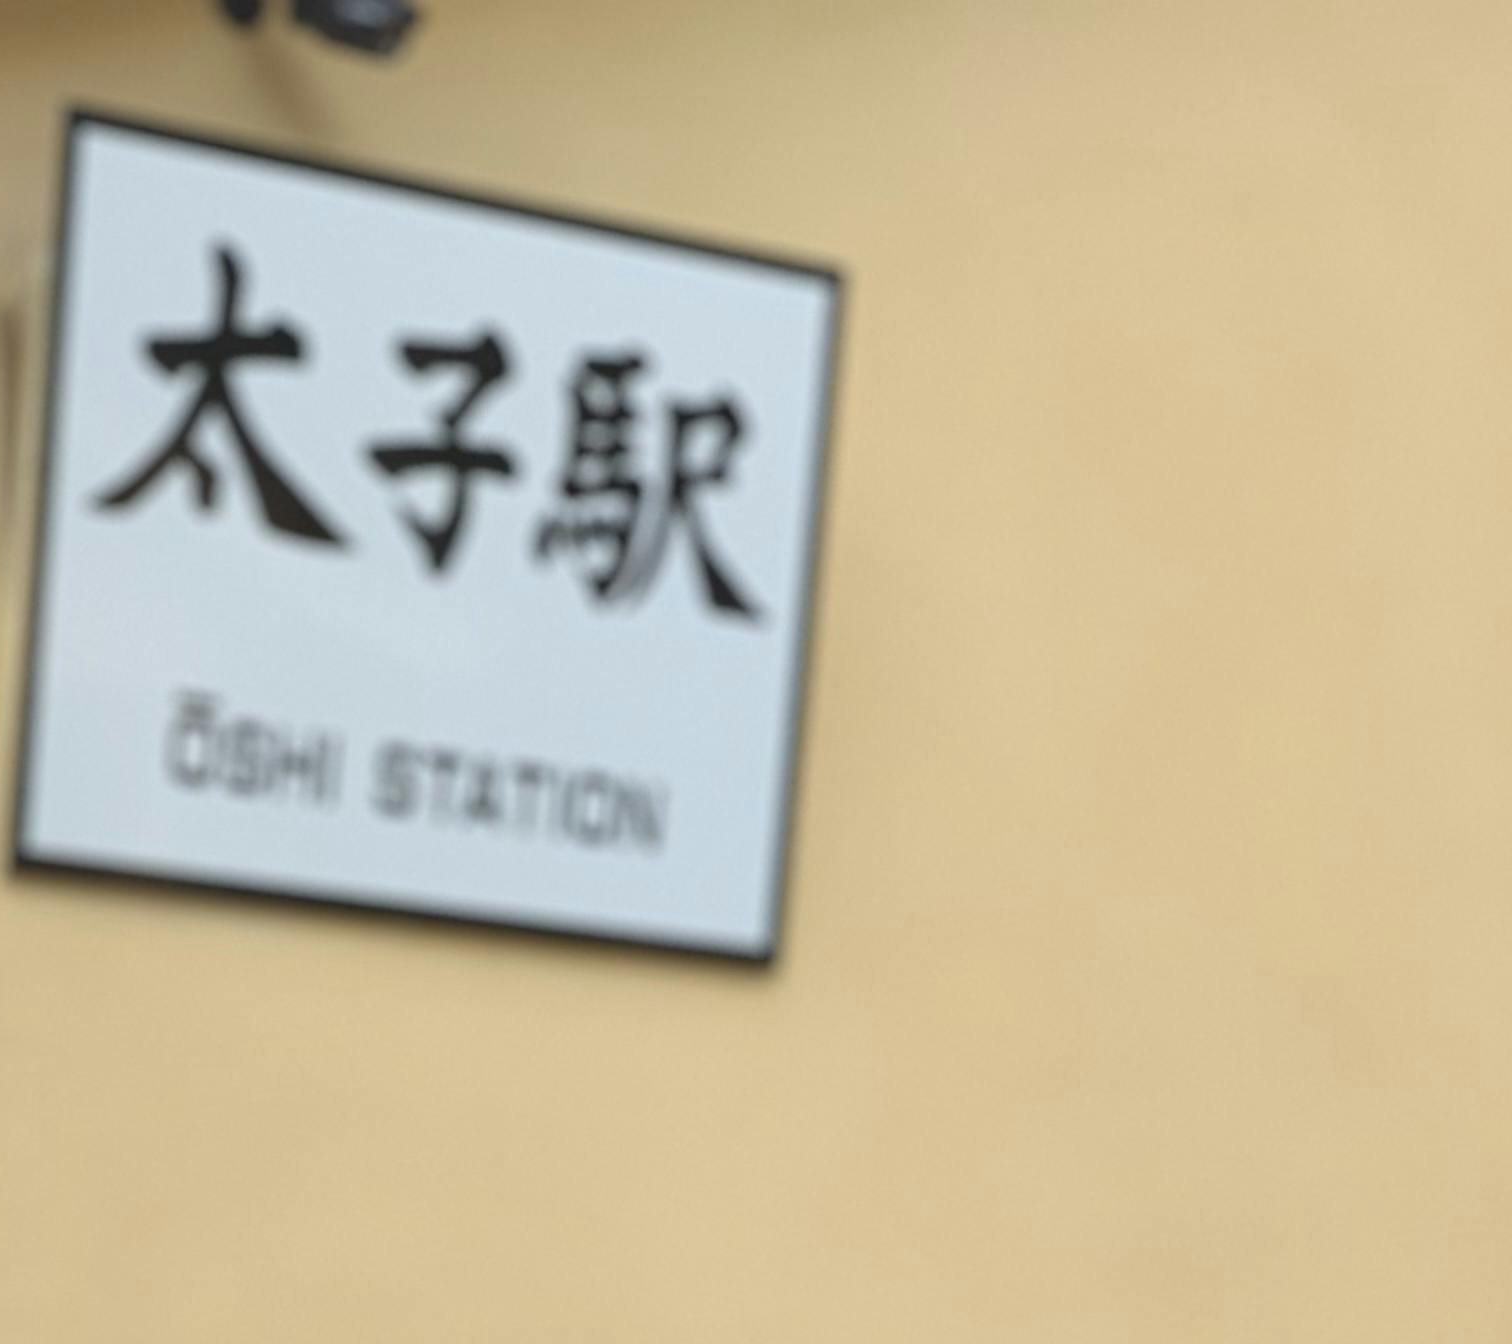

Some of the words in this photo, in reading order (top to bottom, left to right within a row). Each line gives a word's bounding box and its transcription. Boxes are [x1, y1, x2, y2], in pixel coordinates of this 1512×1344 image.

[91, 240, 768, 624] 太子駅
[372, 738, 668, 853] STATION
